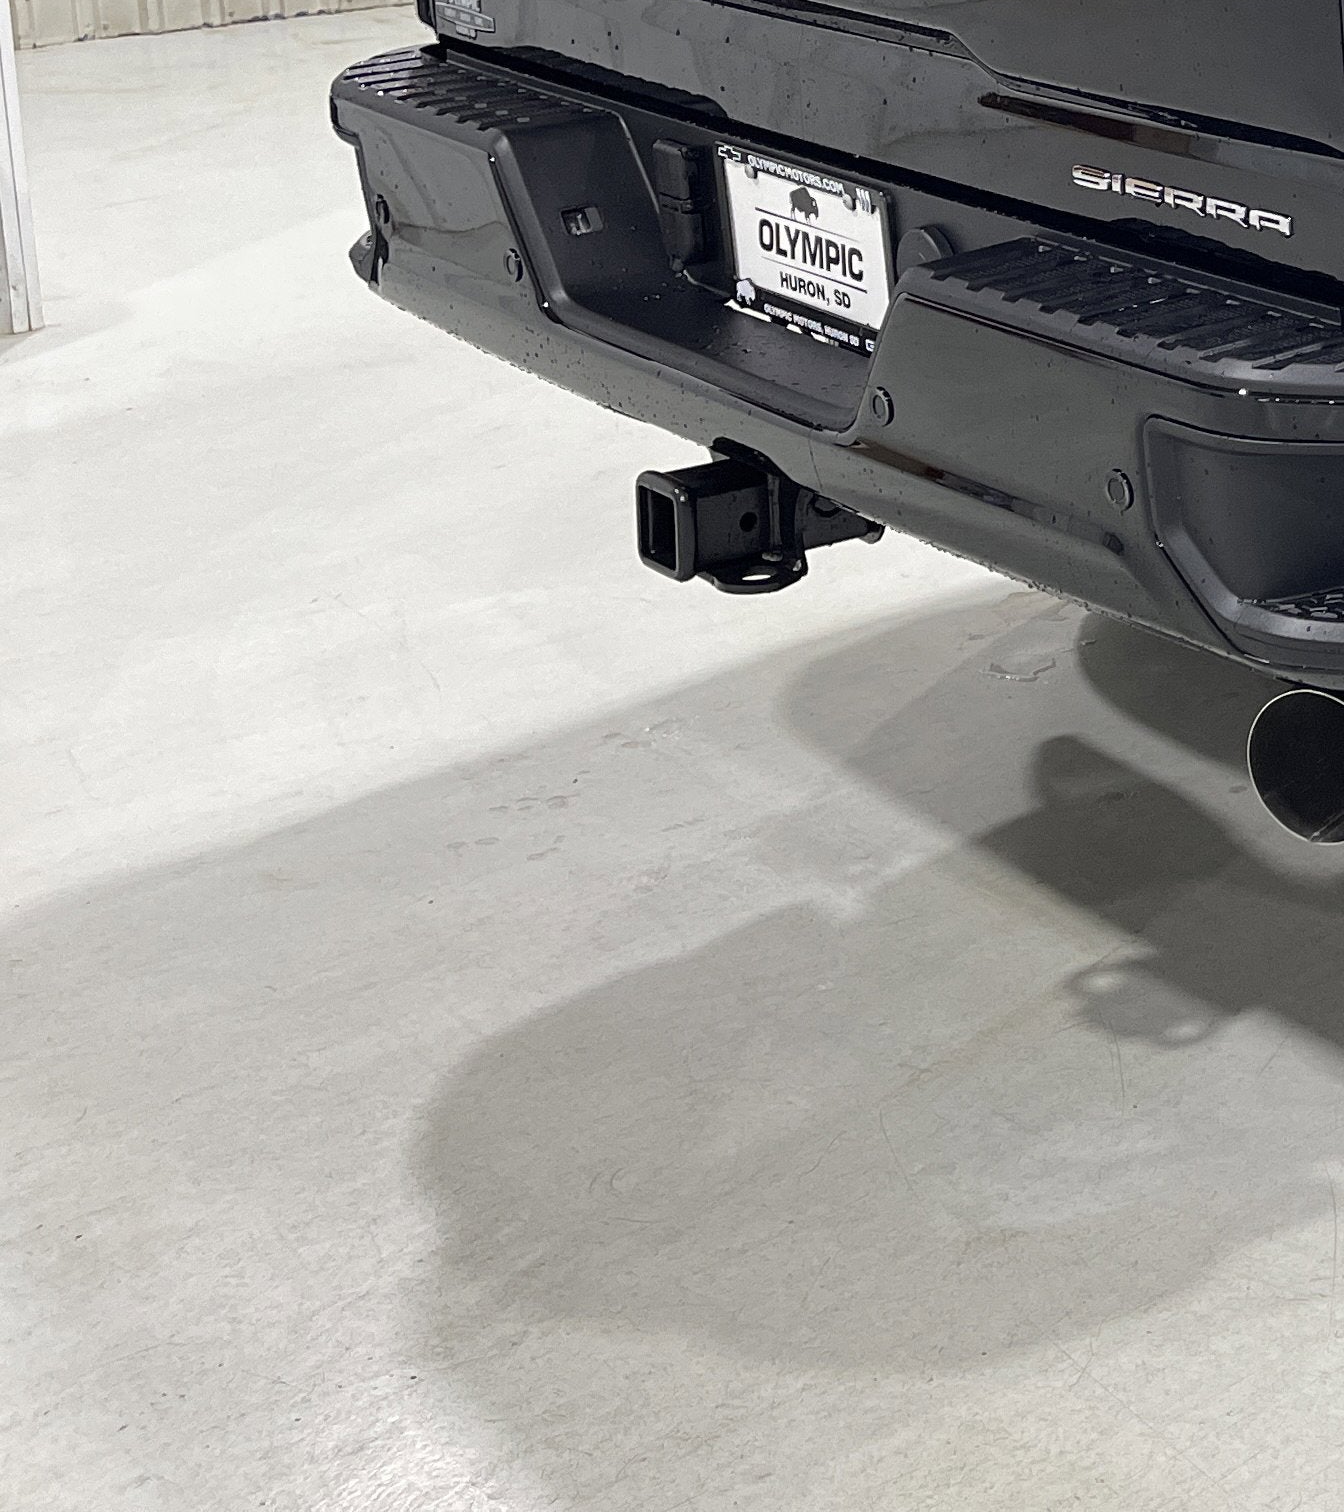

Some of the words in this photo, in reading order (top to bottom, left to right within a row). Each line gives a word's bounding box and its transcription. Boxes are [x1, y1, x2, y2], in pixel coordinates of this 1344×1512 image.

[1071, 162, 1295, 239] SIERRA
[758, 218, 864, 283] OLYMPIC
[779, 270, 830, 306] HURON,
[834, 289, 851, 309] SD
